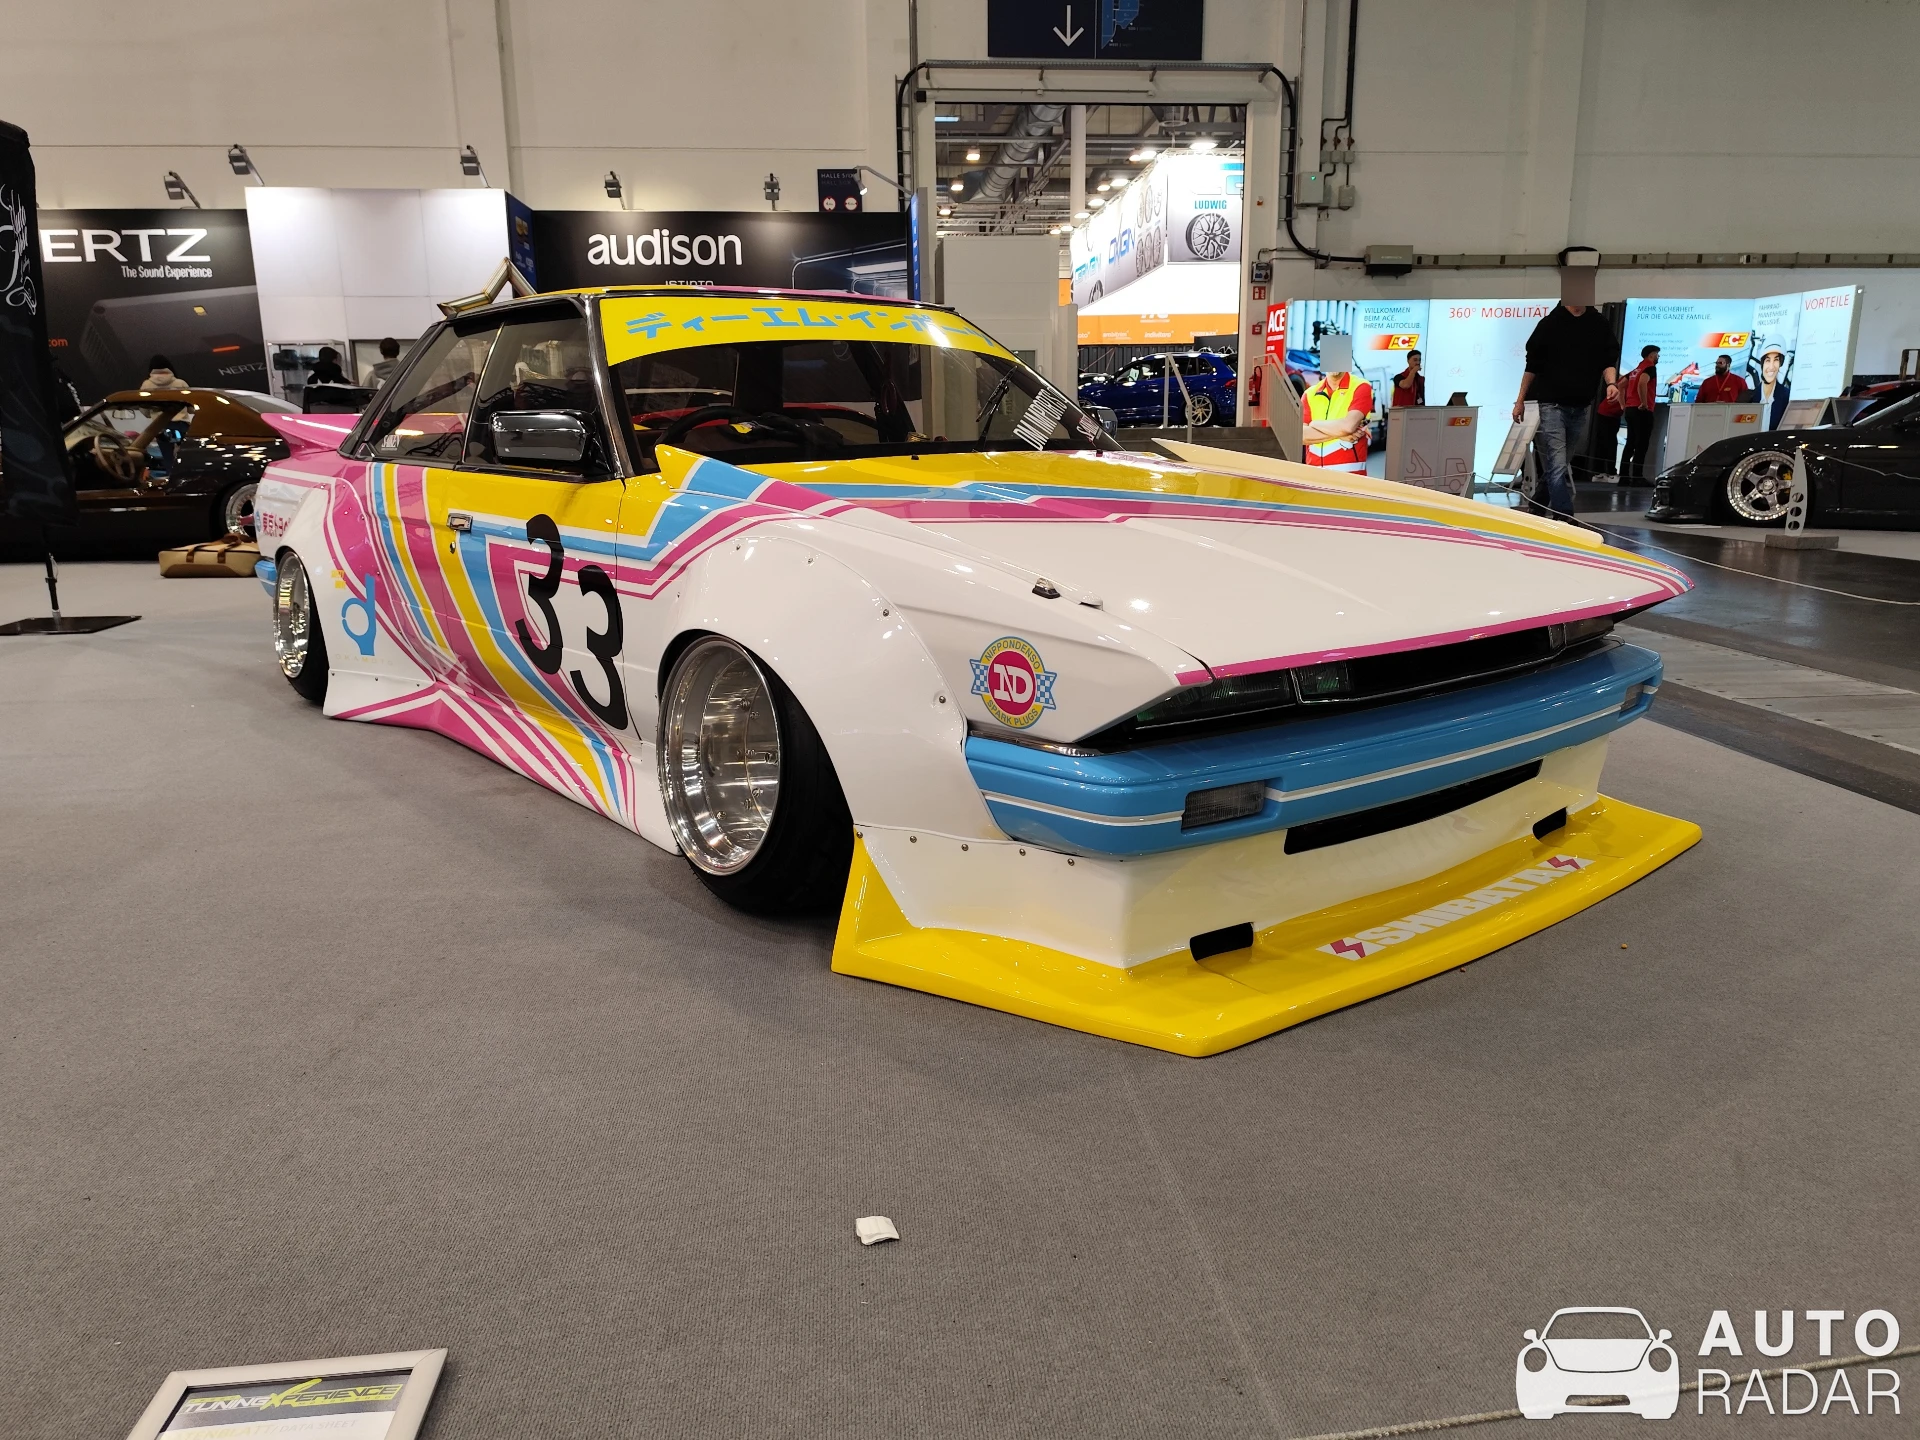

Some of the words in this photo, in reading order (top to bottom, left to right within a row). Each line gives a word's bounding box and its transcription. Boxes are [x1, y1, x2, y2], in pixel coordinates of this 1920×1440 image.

[1194, 200, 1227, 209] LUDWIG
[40, 228, 211, 262] ERTZ
[587, 228, 743, 266] audison
[121, 265, 137, 278] The
[139, 265, 164, 278] Sound
[165, 265, 213, 280] Experience
[1804, 294, 1850, 310] VORTEILE
[1449, 307, 1477, 318] 360°
[1481, 304, 1549, 318] MOBILITÄT
[1267, 309, 1286, 333] ACE
[1391, 336, 1417, 348] ACE
[1721, 334, 1747, 346] ACE
[1454, 417, 1472, 426] ACE
[1741, 414, 1757, 423] ACE
[1013, 420, 1050, 451] DM
[514, 513, 629, 730] 33
[984, 639, 1041, 670] NIPPONDENSO
[987, 699, 1012, 725] SPARK
[1013, 708, 1039, 726] PLUGS
[1355, 867, 1571, 946] SHIBATA
[317, 1420, 359, 1430] SHEET
